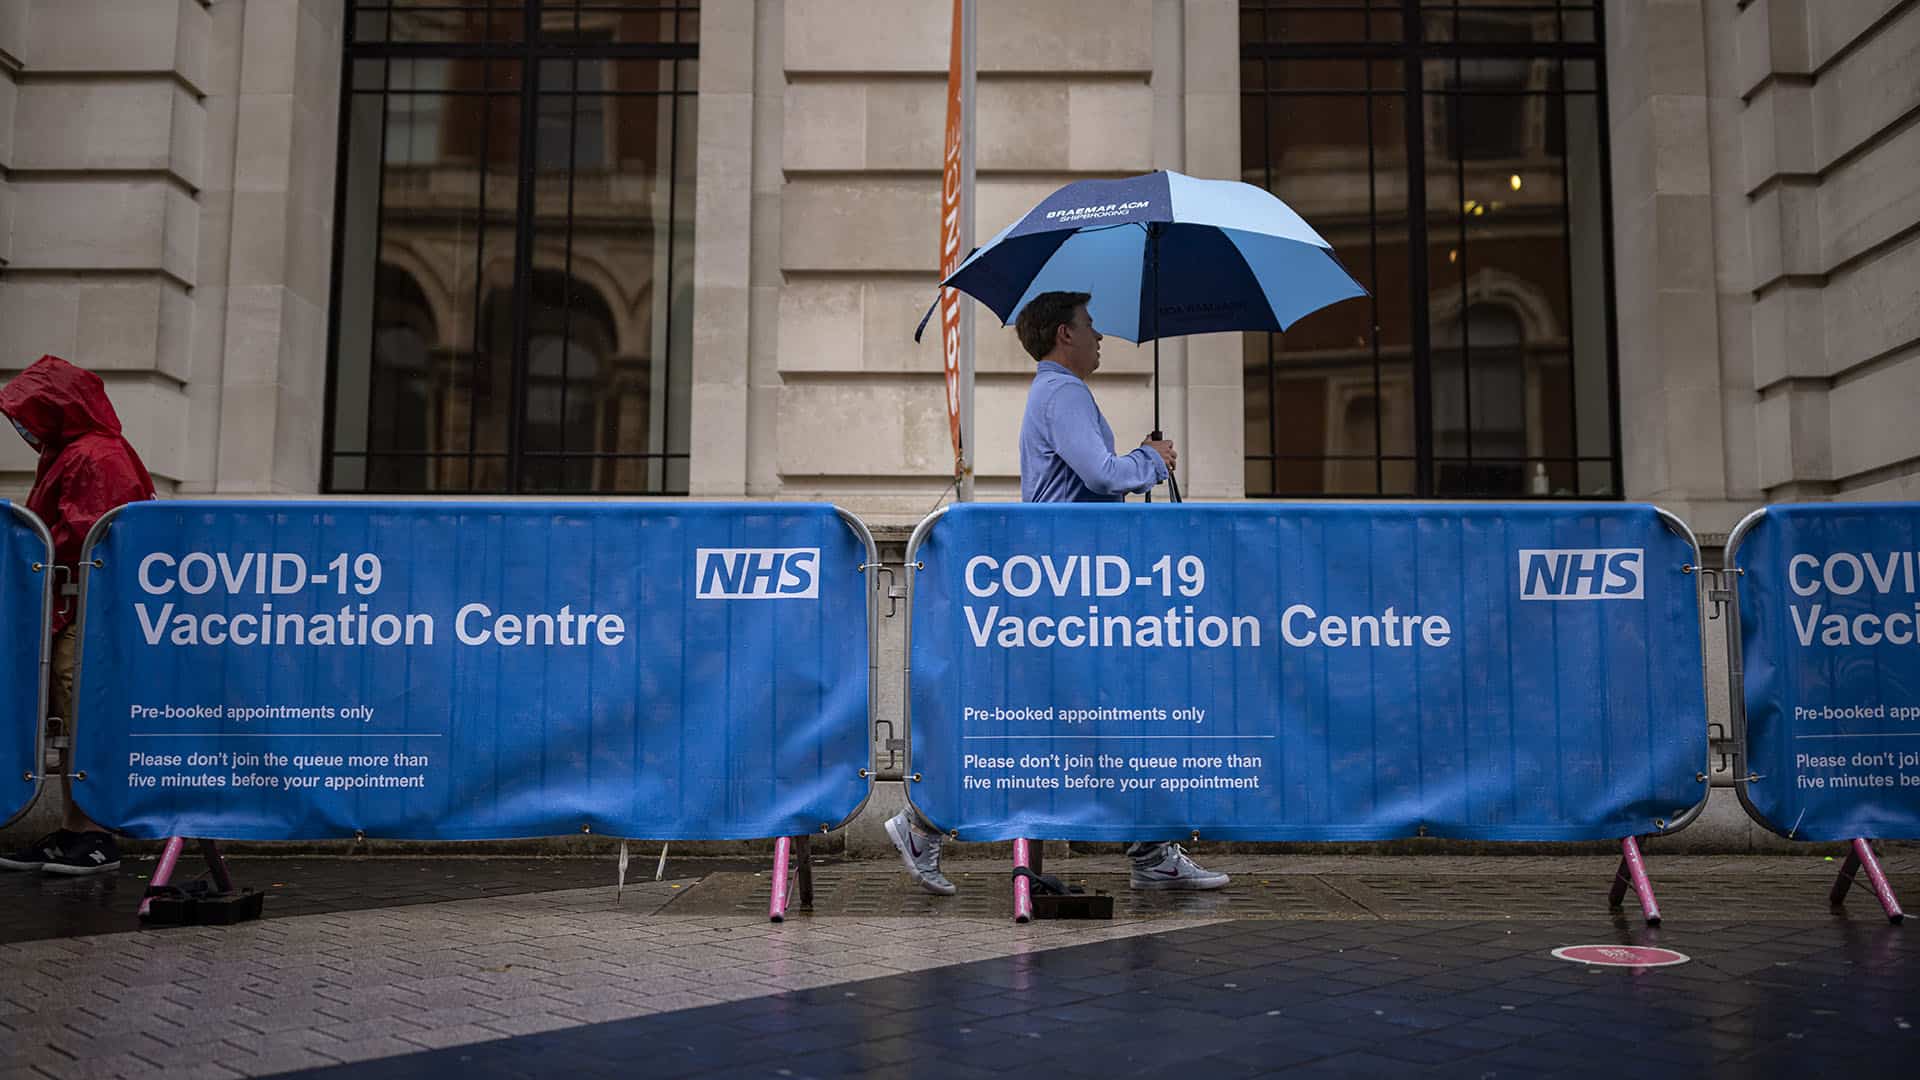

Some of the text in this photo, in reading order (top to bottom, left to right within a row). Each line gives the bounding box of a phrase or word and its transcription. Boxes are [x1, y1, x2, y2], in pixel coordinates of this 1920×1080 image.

[1046, 200, 1150, 219] BRAEMAR ACM
[139, 552, 381, 594] COVID-19
[700, 552, 815, 594] NHS
[965, 555, 1204, 597] COVID-19
[1524, 553, 1639, 595] NHS
[1789, 552, 1920, 596] COVI
[135, 603, 624, 645] Vaccination Centre
[963, 605, 1450, 647] Vaccination Centre
[1790, 602, 1920, 646] Vacci
[131, 705, 374, 722] Pre-booked appointments only
[964, 707, 1205, 723] Pre-booked appointments only
[1795, 705, 1920, 720] Pre-booked app
[130, 752, 428, 769] Please don't join the queue more than
[965, 754, 1261, 771] Please don't join the queue more than
[1797, 752, 1918, 768] Please don't joi
[128, 773, 424, 790] five minutes before your appointment
[964, 774, 1259, 792] five minutes before your appointment
[1797, 773, 1920, 788] five minutes be
